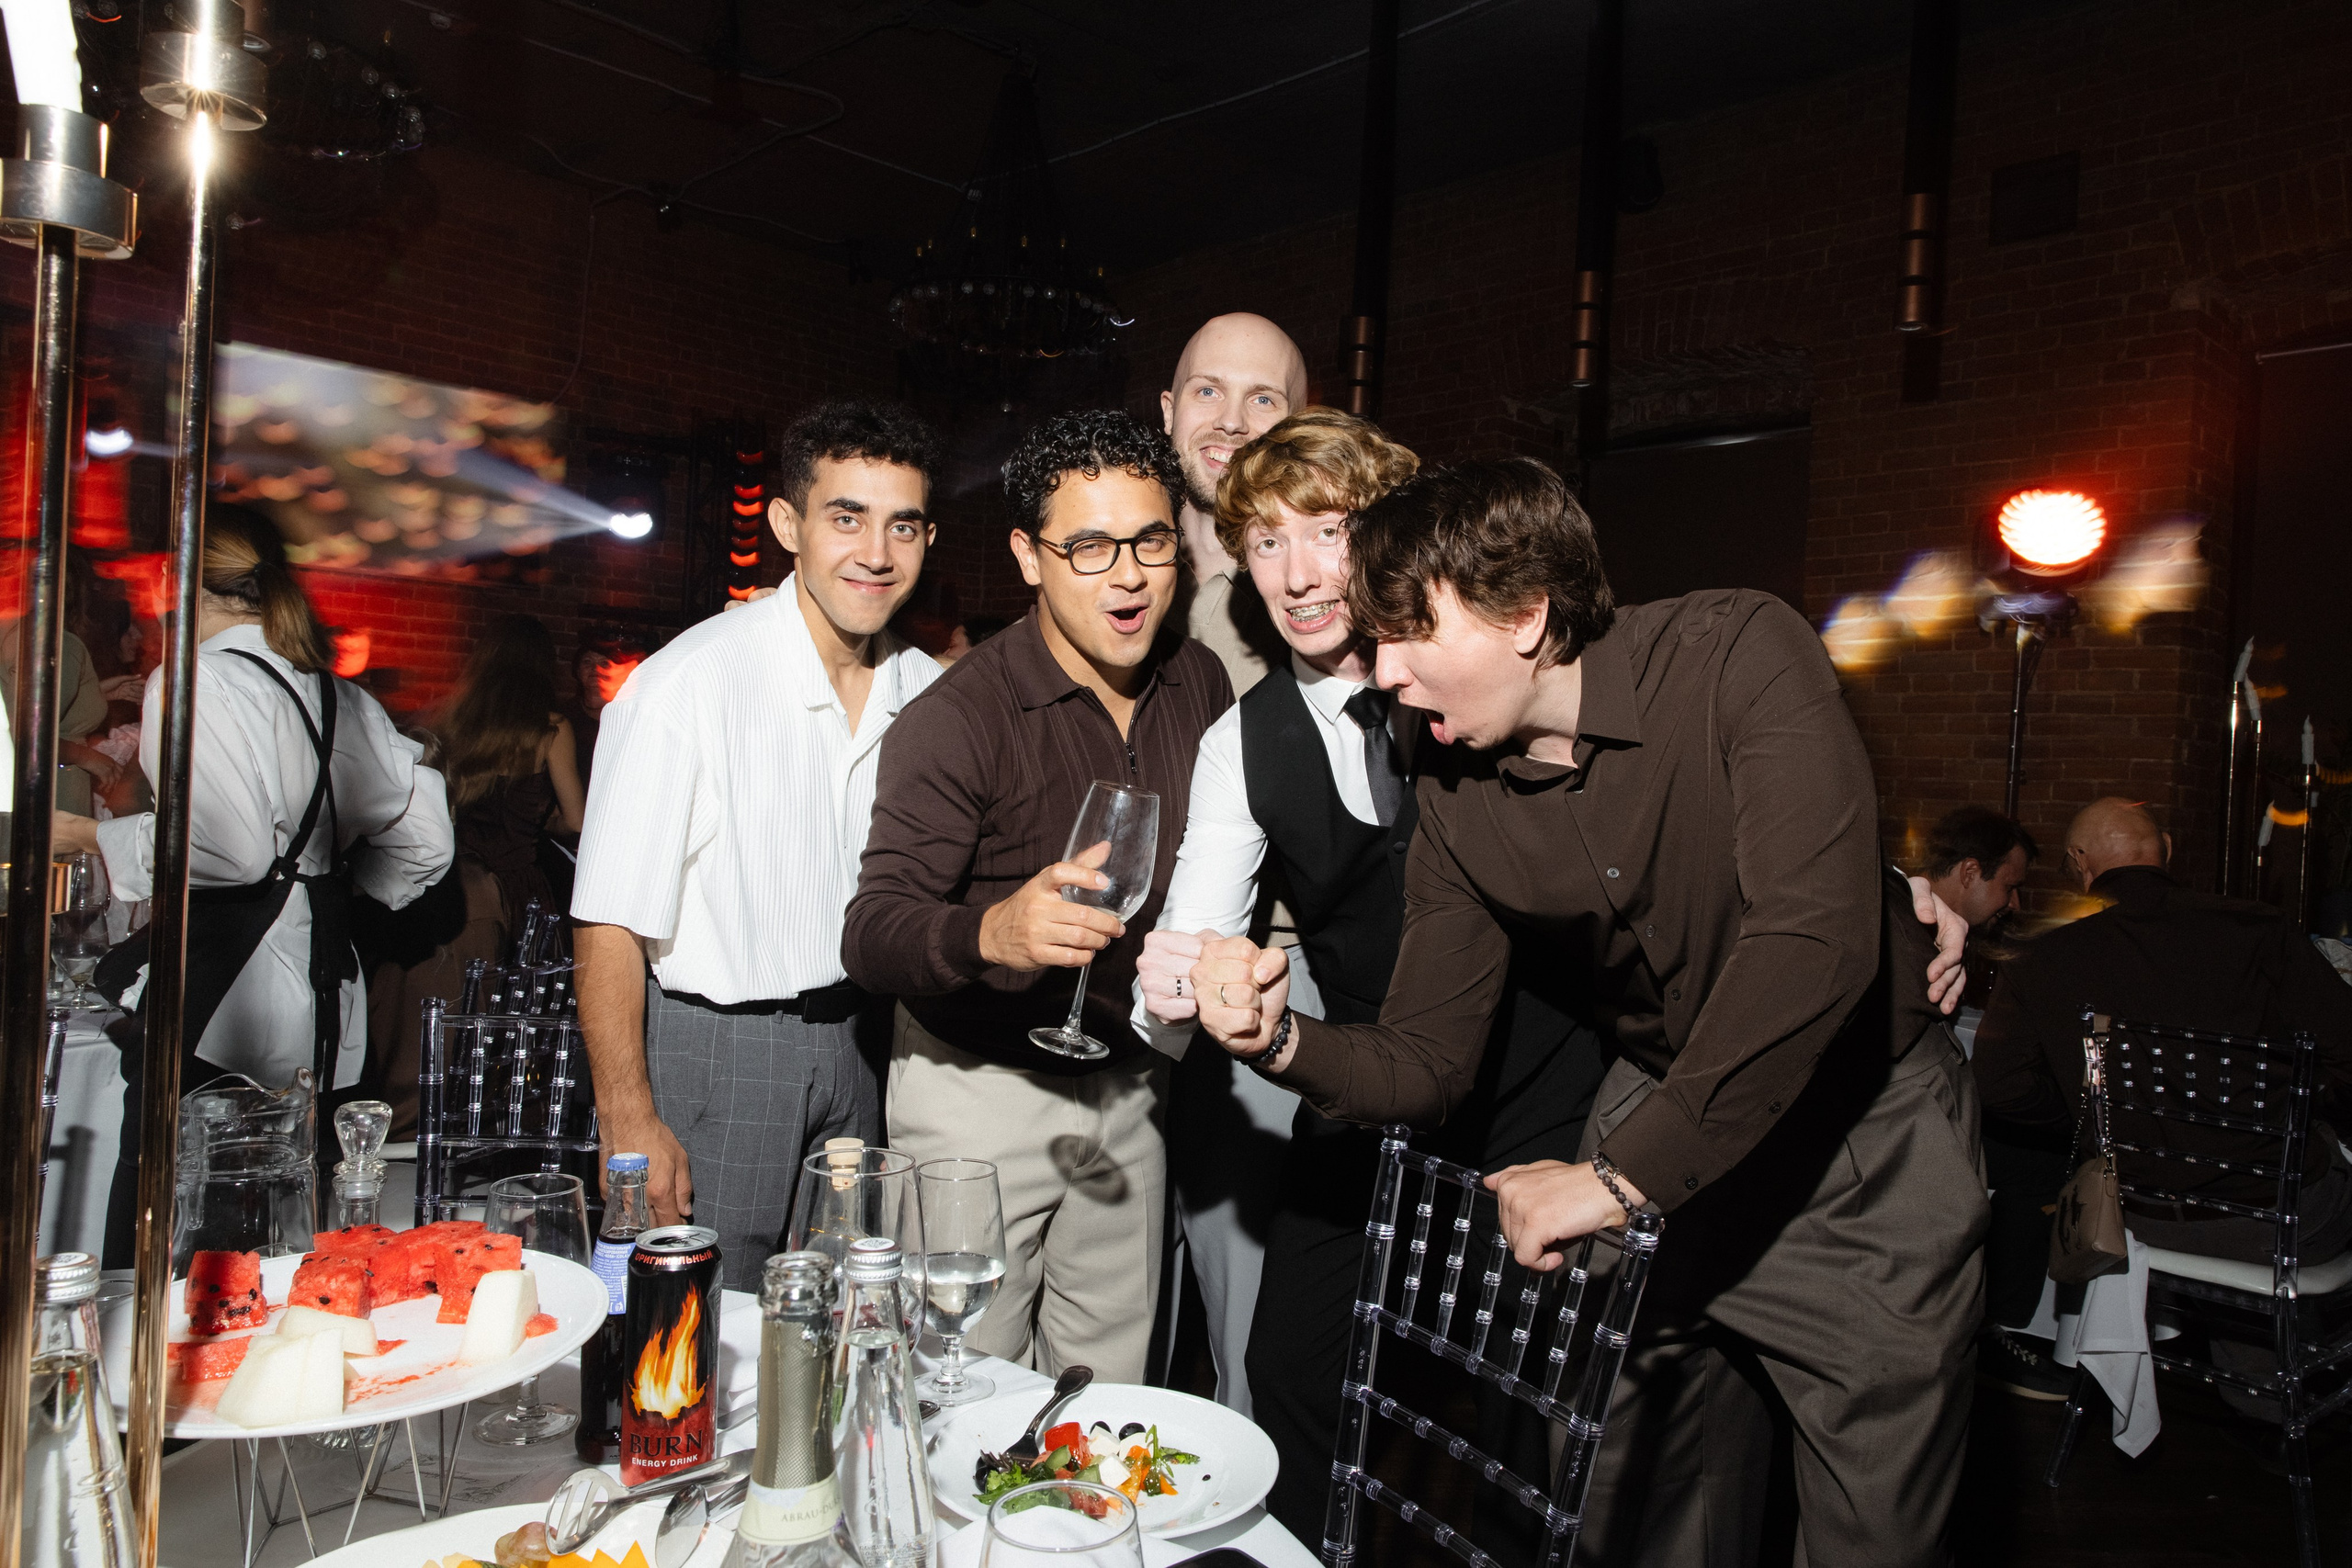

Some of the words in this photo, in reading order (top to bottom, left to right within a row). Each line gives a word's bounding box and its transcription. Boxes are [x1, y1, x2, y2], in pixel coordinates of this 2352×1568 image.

[629, 1428, 703, 1457] BURN
[631, 1457, 666, 1468] ENERGY
[670, 1453, 698, 1467] DRINK
